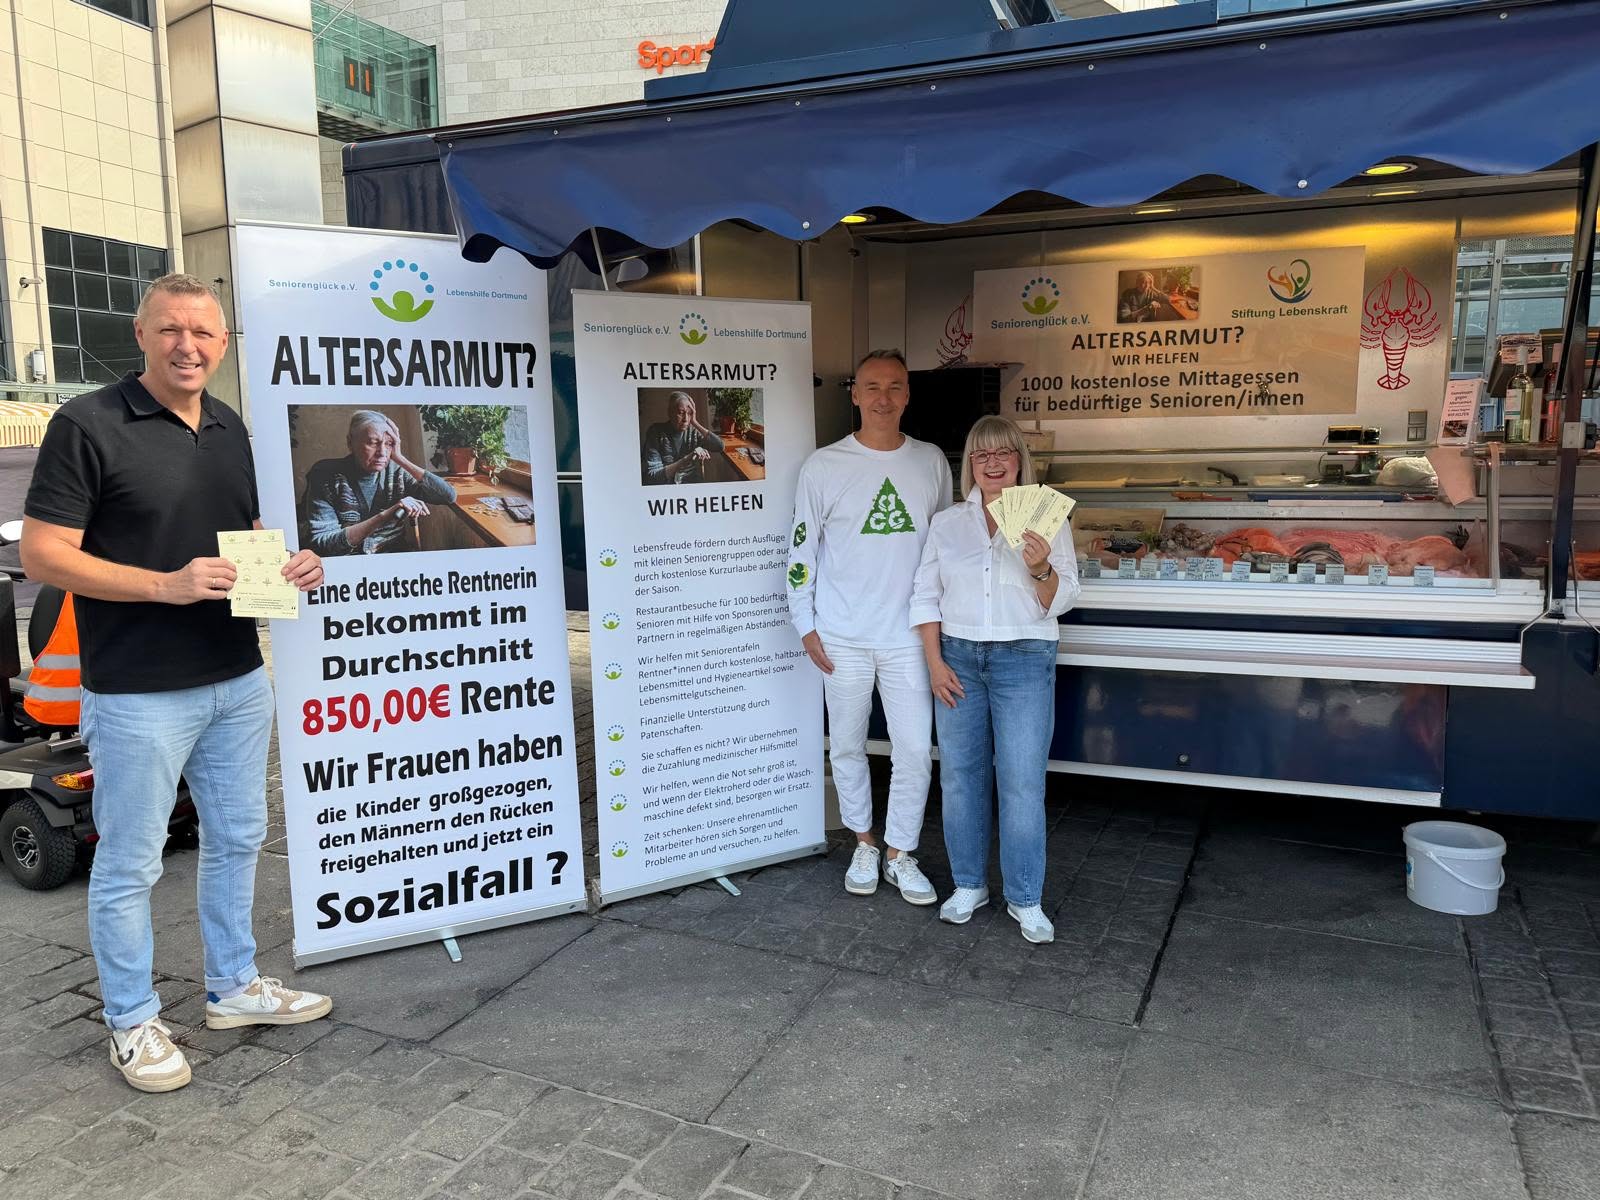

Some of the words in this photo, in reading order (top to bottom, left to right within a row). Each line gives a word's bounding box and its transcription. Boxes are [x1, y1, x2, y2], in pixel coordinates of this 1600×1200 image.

[269, 279, 339, 291] Seniorenglück
[341, 283, 358, 291] e.V.
[446, 289, 490, 298] Lebenshilfe
[491, 291, 527, 300] Dortmund
[991, 315, 1068, 329] Seniorenglück
[1071, 314, 1090, 325] e.V.
[1231, 309, 1275, 319] Stiftung
[1279, 305, 1348, 316] Lebenskraft
[584, 323, 653, 336] Seniorenglück
[655, 326, 671, 335] e.V.
[714, 328, 764, 338] Lebenshilfe
[765, 329, 807, 339] Dortmund
[1072, 326, 1244, 350] ALTERSARMUT?
[271, 335, 536, 388] ALTERSARMUT?
[623, 362, 777, 381] ALTERSARMUT?
[1112, 354, 1140, 366] WIR
[1145, 352, 1199, 365] HELFEN
[1021, 376, 1063, 391] 1000
[1071, 372, 1170, 390] kostenlose
[1179, 370, 1299, 390] Mittagessen
[1014, 397, 1040, 412] für
[1048, 394, 1142, 413] bedürftige
[1150, 388, 1304, 410] Senioren/innen
[647, 498, 688, 516] WIR
[695, 494, 763, 513] HELFEN
[633, 541, 692, 553] Lebensfreude
[694, 539, 726, 548] fördern
[728, 536, 751, 546] durch
[752, 534, 786, 543] Ausflüge
[634, 558, 649, 568] mit
[651, 556, 682, 567] kleinen
[684, 551, 755, 564] Seniorengruppen
[756, 547, 774, 557] oder
[776, 547, 789, 555] auc
[634, 571, 659, 582] durch
[661, 568, 707, 579] kostenlose
[709, 563, 757, 575] Kurzurlaube
[307, 581, 350, 605] Eine
[356, 573, 443, 601] deutsche
[448, 566, 537, 594] Rentnerin
[635, 587, 650, 596] der
[651, 585, 682, 595] Saison.
[636, 600, 717, 616] Restaurantbesuche
[719, 598, 731, 607] für
[734, 596, 749, 606] 100
[636, 619, 674, 630] Senioren
[676, 617, 691, 625] mit
[693, 613, 713, 623] Hilfe
[714, 613, 730, 621] von
[732, 608, 773, 620] Sponsoren
[774, 604, 789, 614] und
[324, 605, 481, 641] bekommt
[490, 602, 526, 625] im
[637, 633, 674, 644] Partnern
[677, 630, 685, 638] in
[687, 625, 743, 639] regelmäßigen
[745, 619, 787, 630] Abständen.
[322, 638, 533, 681] Durchschnitt
[638, 656, 653, 665] Wir
[655, 652, 683, 663] helfen
[685, 651, 699, 659] mit
[701, 642, 760, 658] Seniorentafeln
[703, 660, 728, 670] durch
[729, 655, 773, 667] kostenlose,
[775, 649, 807, 660] haltbare
[639, 677, 694, 693] Lebensmittel
[696, 675, 712, 685] und
[714, 666, 771, 683] Hygieneartikel
[772, 664, 794, 674] sowie
[303, 684, 451, 735] 850,00€
[461, 677, 555, 715] Rente
[639, 685, 746, 706] Lebensmittelgutscheinen.
[640, 712, 685, 727] Finanzielle
[687, 703, 746, 718] Unterstützung
[747, 698, 770, 709] durch
[641, 724, 703, 740] Patenschaften.
[641, 752, 654, 761] Sie
[656, 746, 692, 758] schaffen
[694, 744, 703, 752] es
[705, 737, 730, 749] nicht?
[732, 737, 747, 745] Wir
[749, 728, 797, 742] übernehmen
[303, 757, 358, 793] Wir
[367, 748, 470, 784] Frauen
[478, 734, 562, 768] haben
[642, 765, 655, 774] die
[657, 758, 701, 772] Zuzahlung
[702, 748, 758, 763] medizinischer
[759, 738, 798, 752] Hilfsmittel
[642, 786, 658, 795] Wir
[660, 780, 690, 792] helfen,
[692, 776, 715, 785] wenn
[717, 773, 730, 781] die
[731, 769, 746, 778] Not
[748, 766, 765, 775] sehr
[767, 761, 785, 773] groß
[786, 759, 797, 767] ist,
[643, 797, 660, 809] und
[661, 794, 686, 805] wenn
[687, 791, 702, 800] der
[704, 779, 751, 796] Elektroherd
[752, 777, 771, 787] oder
[773, 774, 785, 783] die
[786, 768, 813, 780] Wasch-
[317, 807, 347, 825] die
[356, 797, 420, 819] Kinder
[429, 778, 552, 812] großgezogen,
[644, 808, 684, 822] maschine
[686, 802, 712, 813] defekt
[714, 796, 734, 808] sind,
[736, 790, 772, 804] besorgen
[774, 786, 786, 795] wir
[788, 782, 811, 792] Ersatz.
[319, 833, 355, 850] den
[361, 818, 445, 843] Männern
[451, 812, 484, 828] den
[490, 801, 553, 822] Rücken
[644, 832, 660, 842] Zeit
[662, 824, 704, 838] schenken:
[707, 817, 736, 829] Unsere
[737, 804, 798, 822] ehrenamtlichen
[320, 844, 438, 874] freigehalten
[444, 834, 478, 854] und
[481, 827, 523, 852] jetzt
[527, 822, 553, 839] ein
[645, 839, 693, 854] Mitarbeiter
[695, 833, 720, 844] hören
[721, 828, 737, 838] sich
[739, 823, 766, 835] Sorgen
[768, 818, 783, 828] und
[645, 853, 686, 868] Probleme
[701, 845, 717, 855] und
[718, 837, 762, 851] versuchen,
[763, 834, 772, 842] zu
[774, 828, 800, 839] helfen.
[317, 856, 533, 930] Sozialfall
[546, 851, 568, 885] ?
